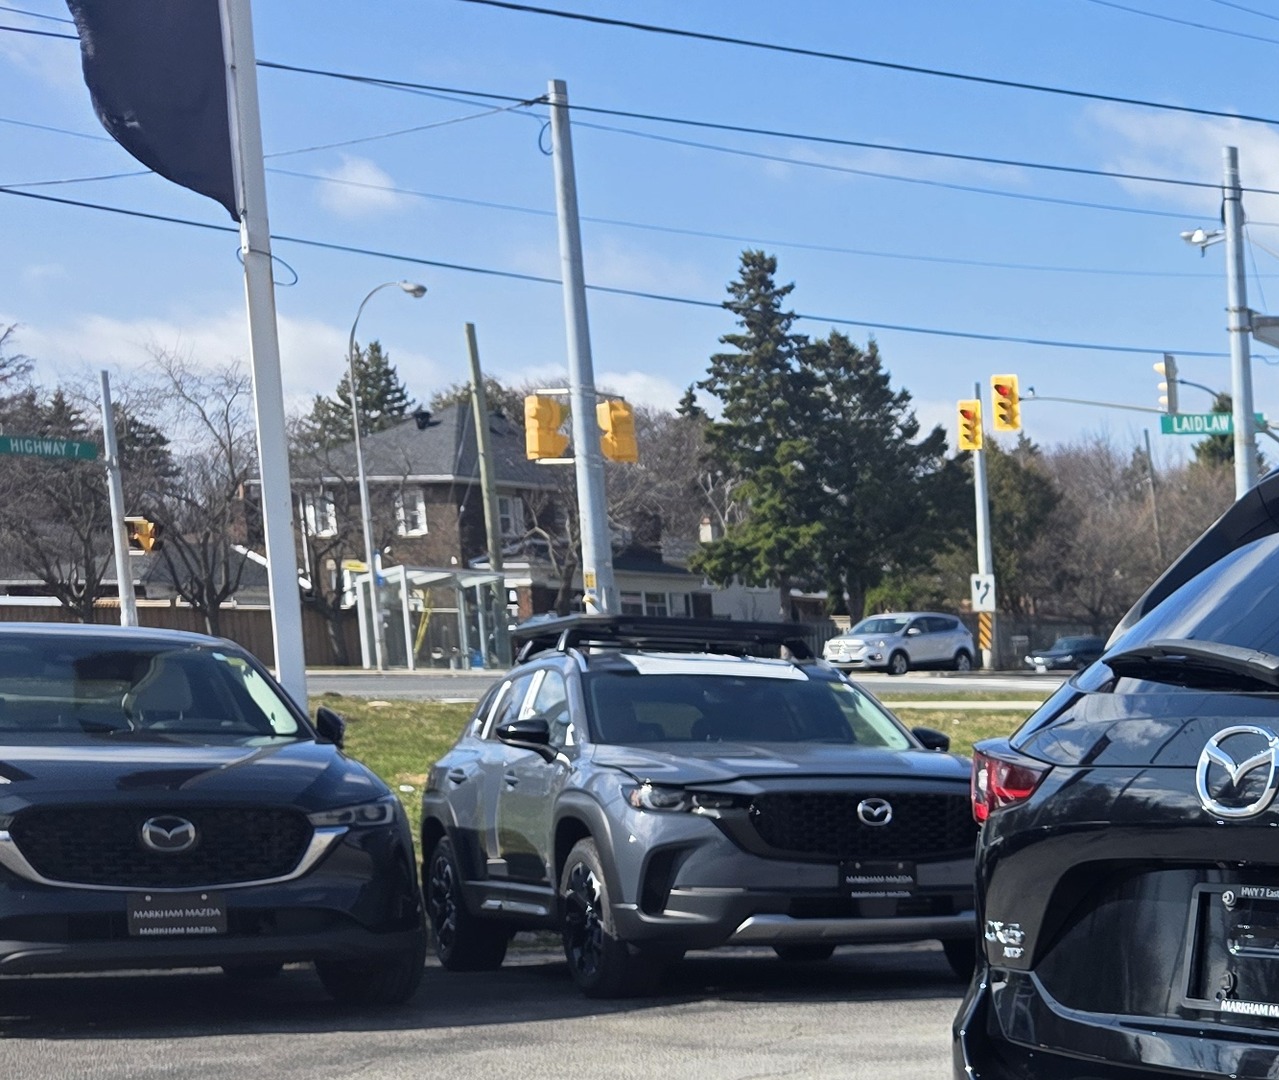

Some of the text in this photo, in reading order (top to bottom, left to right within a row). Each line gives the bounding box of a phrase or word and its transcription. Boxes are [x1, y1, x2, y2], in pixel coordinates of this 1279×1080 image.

[1172, 414, 1230, 432] LAIDLAW
[9, 438, 81, 456] HIGHWAY 7
[1241, 886, 1259, 897] HWY
[1259, 888, 1265, 897] 7
[1266, 889, 1279, 898] East
[133, 907, 221, 919] MARKHAM MAZDA
[1220, 1000, 1268, 1017] MARKHAM
